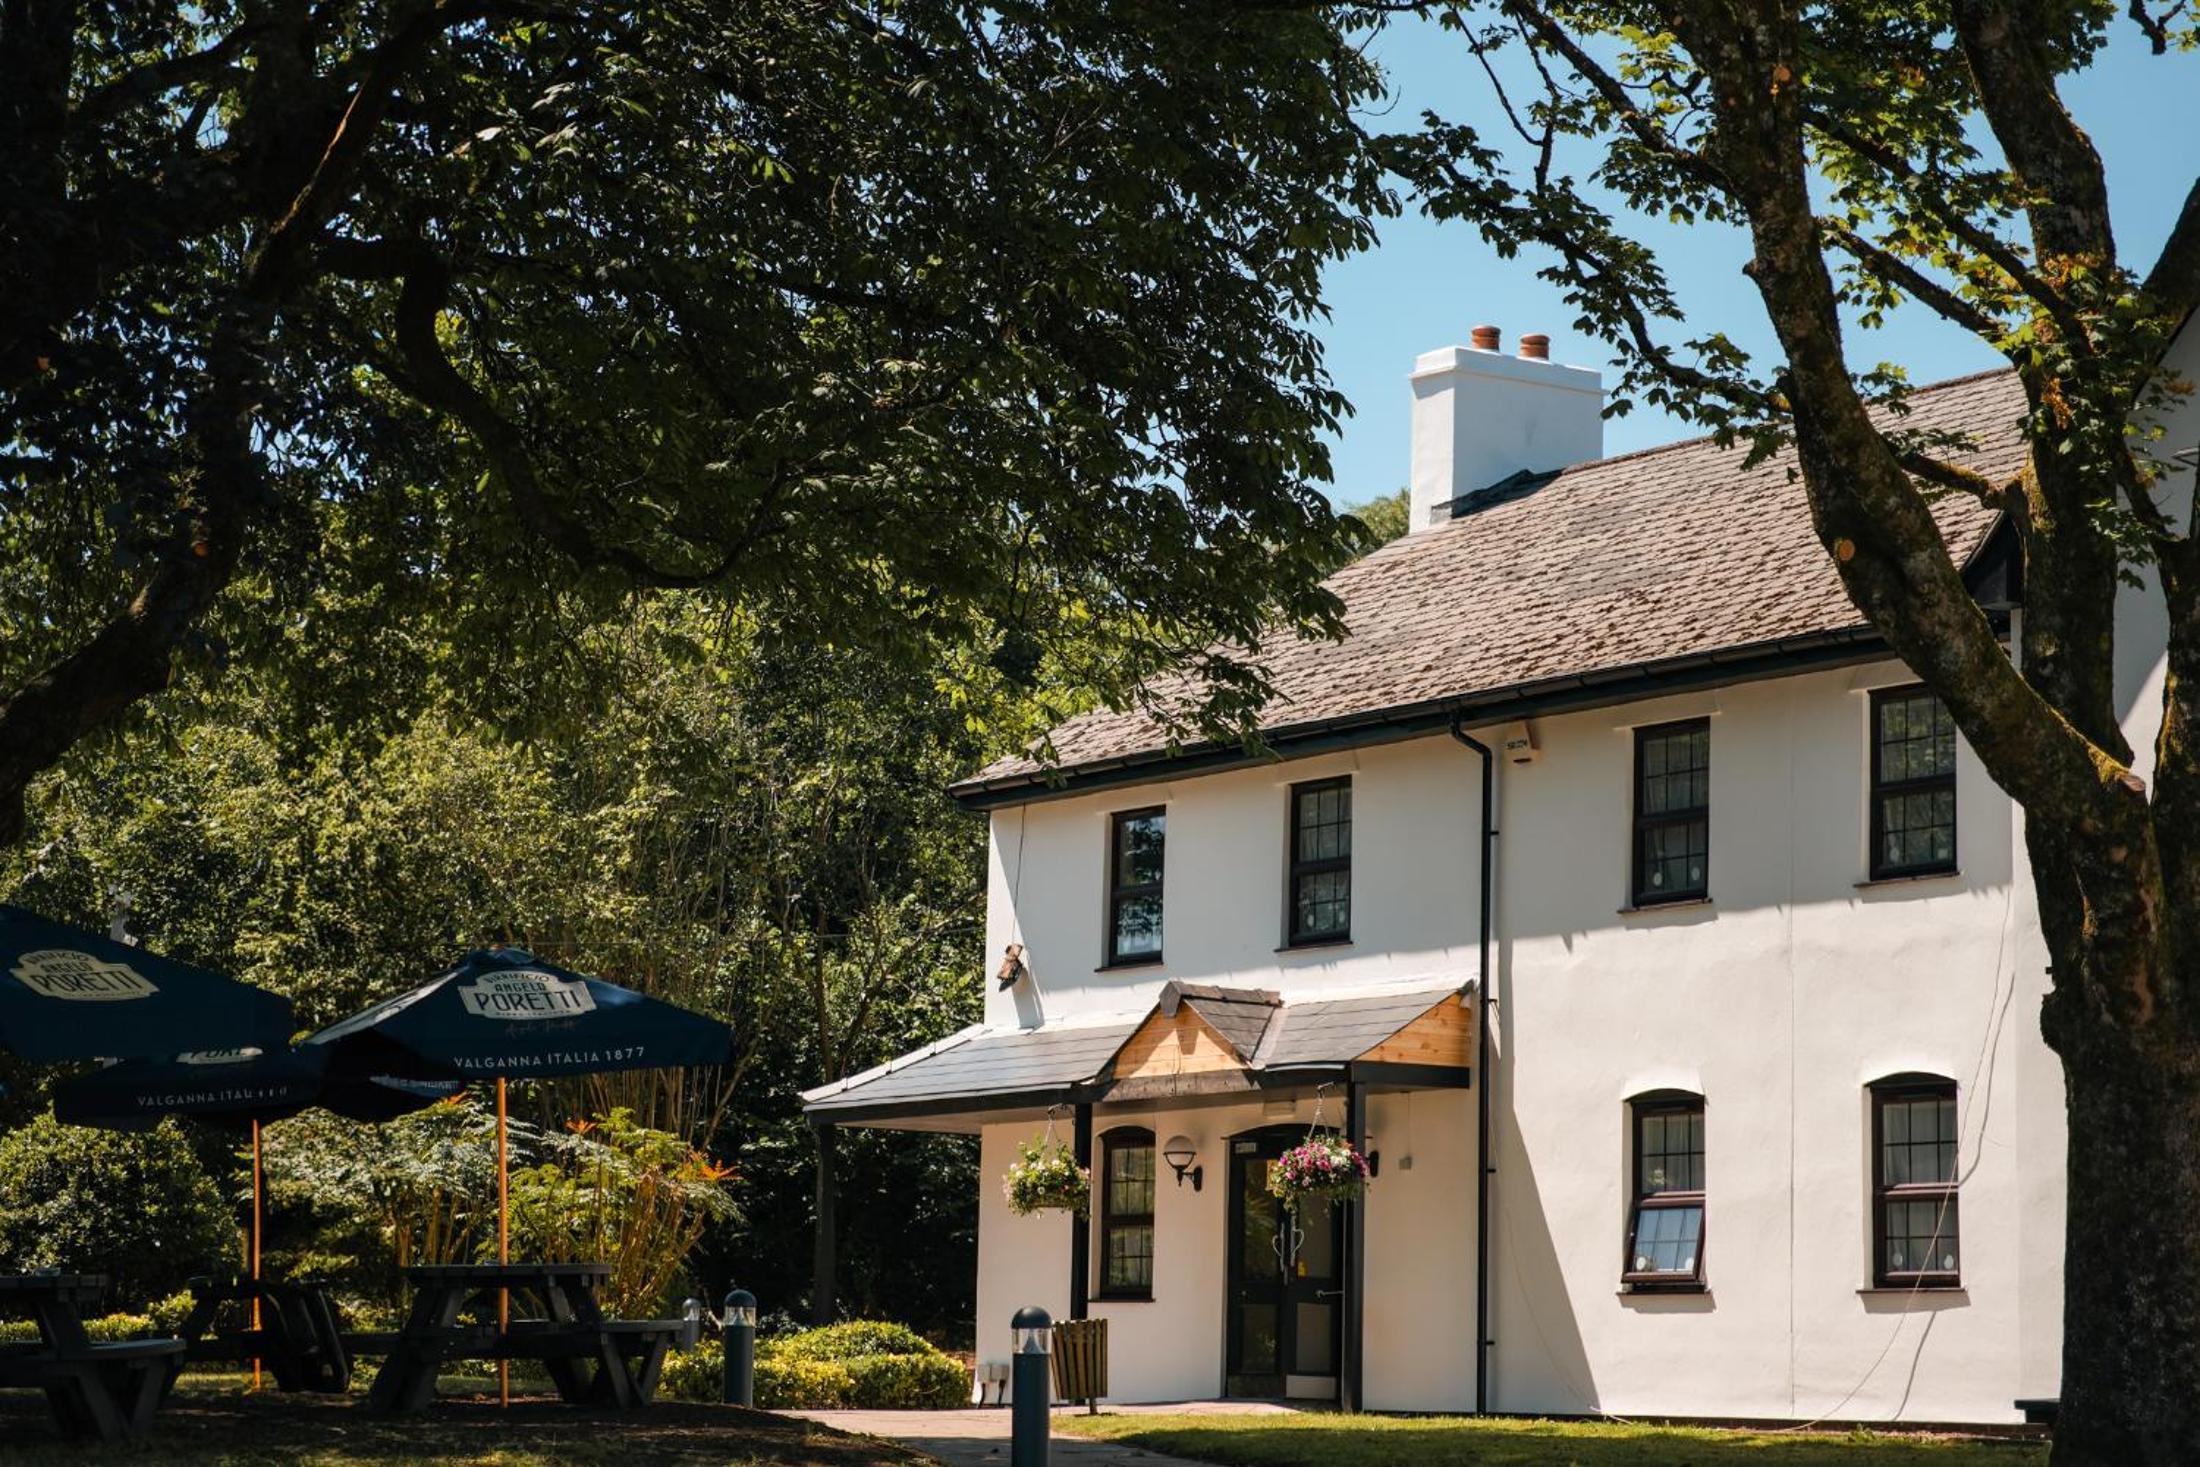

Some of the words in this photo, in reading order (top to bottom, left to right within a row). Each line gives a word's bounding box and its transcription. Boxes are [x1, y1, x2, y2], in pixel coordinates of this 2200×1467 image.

[30, 970, 144, 992] PORETTI
[495, 982, 547, 992] ANGELO
[474, 990, 581, 1011] PORETTI
[453, 1055, 541, 1068] VALGANNA
[547, 1052, 600, 1065] ITALIA
[605, 1046, 645, 1061] 1877
[137, 1092, 215, 1106] VALGANNA
